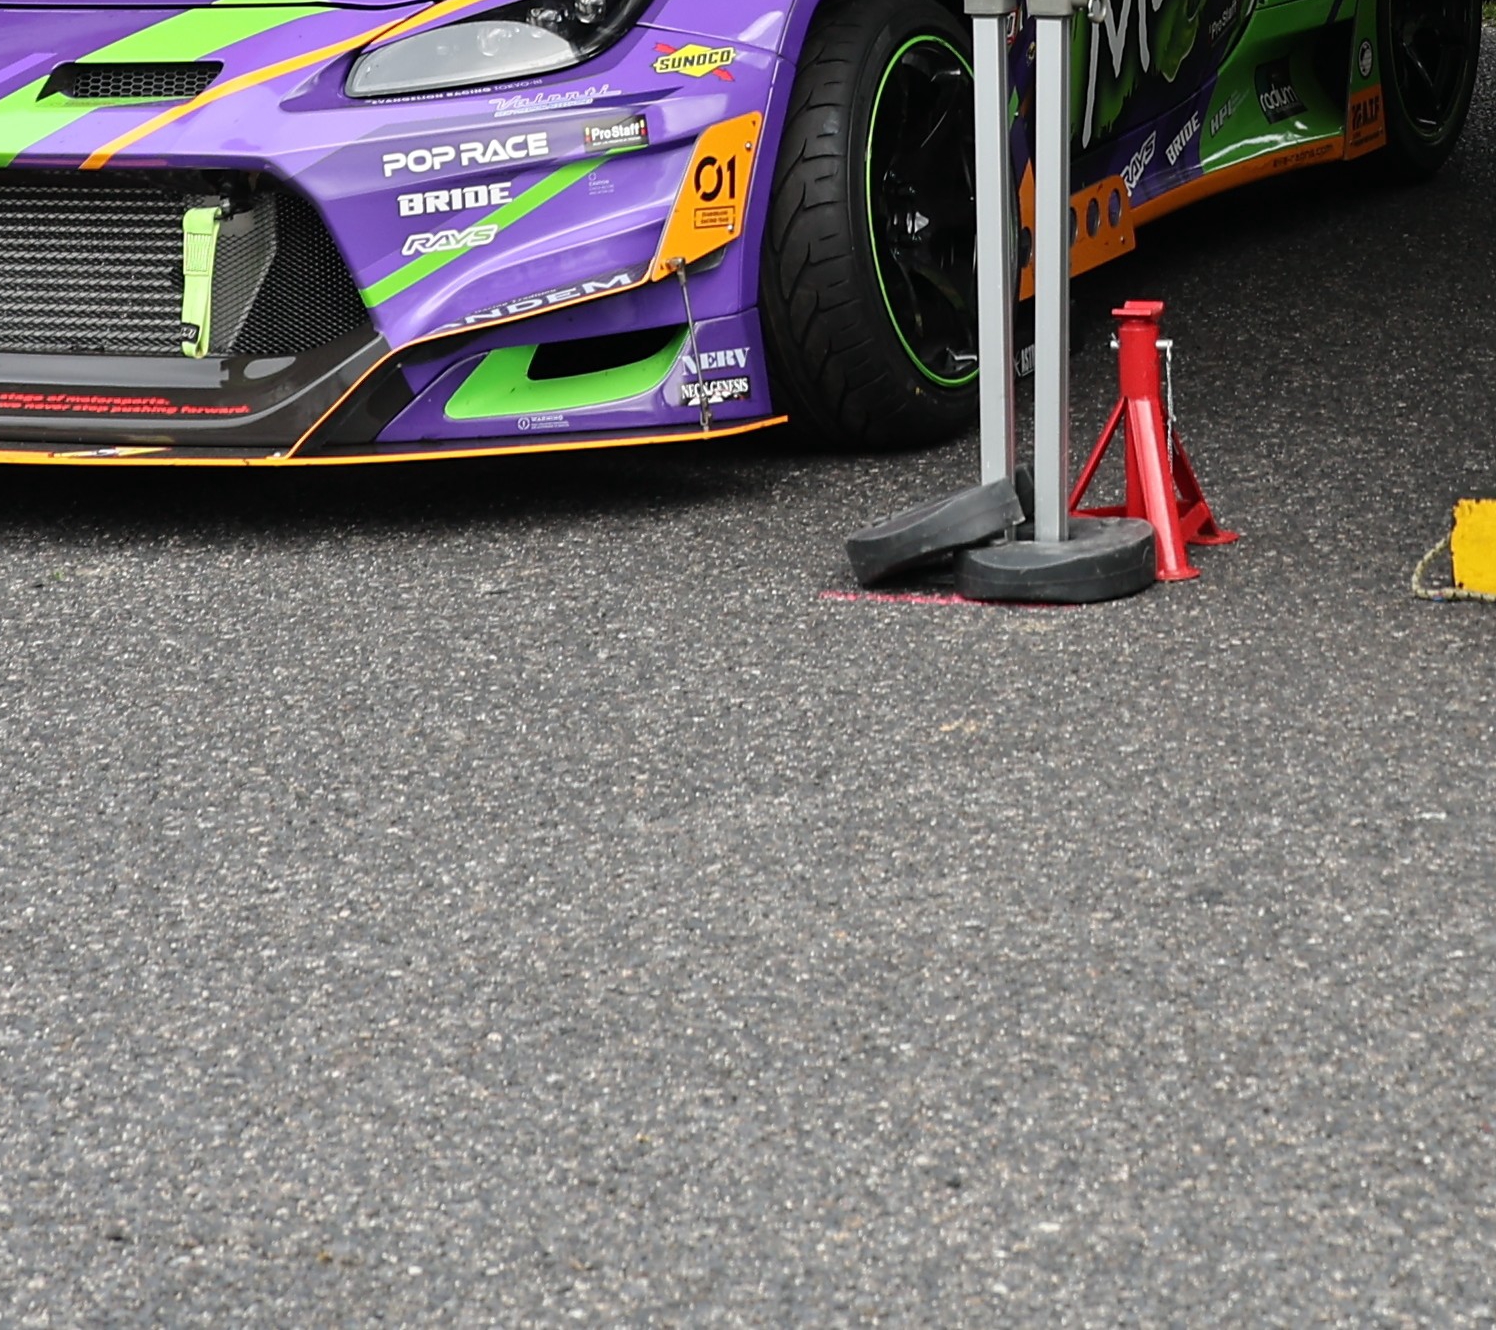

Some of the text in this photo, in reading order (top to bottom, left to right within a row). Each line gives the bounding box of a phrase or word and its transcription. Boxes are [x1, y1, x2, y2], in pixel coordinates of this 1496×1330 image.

[654, 44, 737, 75] SUNOCO
[591, 124, 640, 142] ProStaff
[1164, 110, 1201, 167] BRIDE
[382, 131, 550, 178] POP RACE
[397, 181, 513, 217] BRIDE
[402, 223, 500, 257] RAYS
[680, 346, 751, 376] NERV
